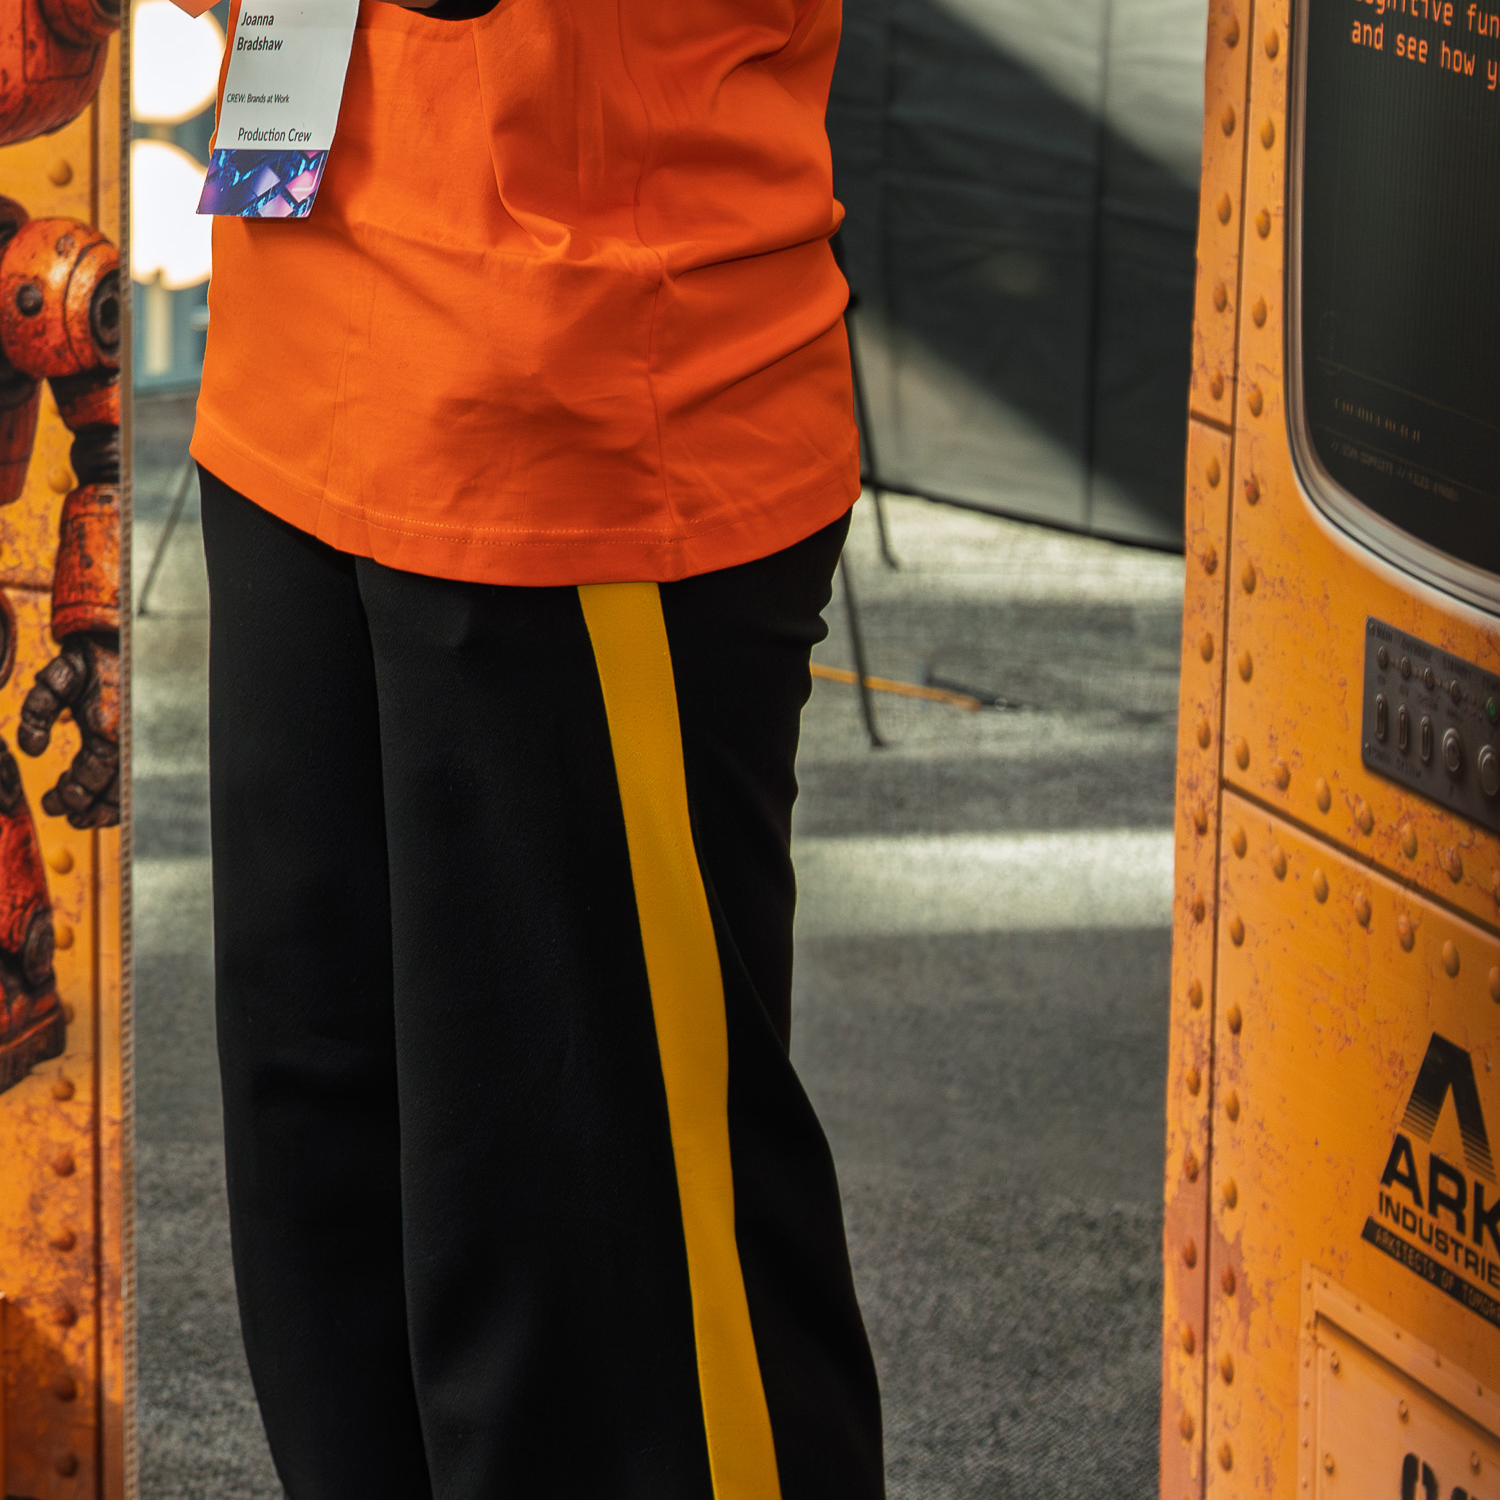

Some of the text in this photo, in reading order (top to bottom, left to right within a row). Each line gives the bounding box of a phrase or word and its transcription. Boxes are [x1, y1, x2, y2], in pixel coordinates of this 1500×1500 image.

[241, 12, 275, 26] Joanna
[237, 36, 283, 51] Bradshaw
[1351, 20, 1384, 51] and
[1396, 33, 1428, 64] see
[1440, 39, 1476, 77] how
[226, 93, 290, 104] CREW: Brands at Work
[238, 127, 312, 142] Production Crew
[1380, 1132, 1500, 1258] ARK
